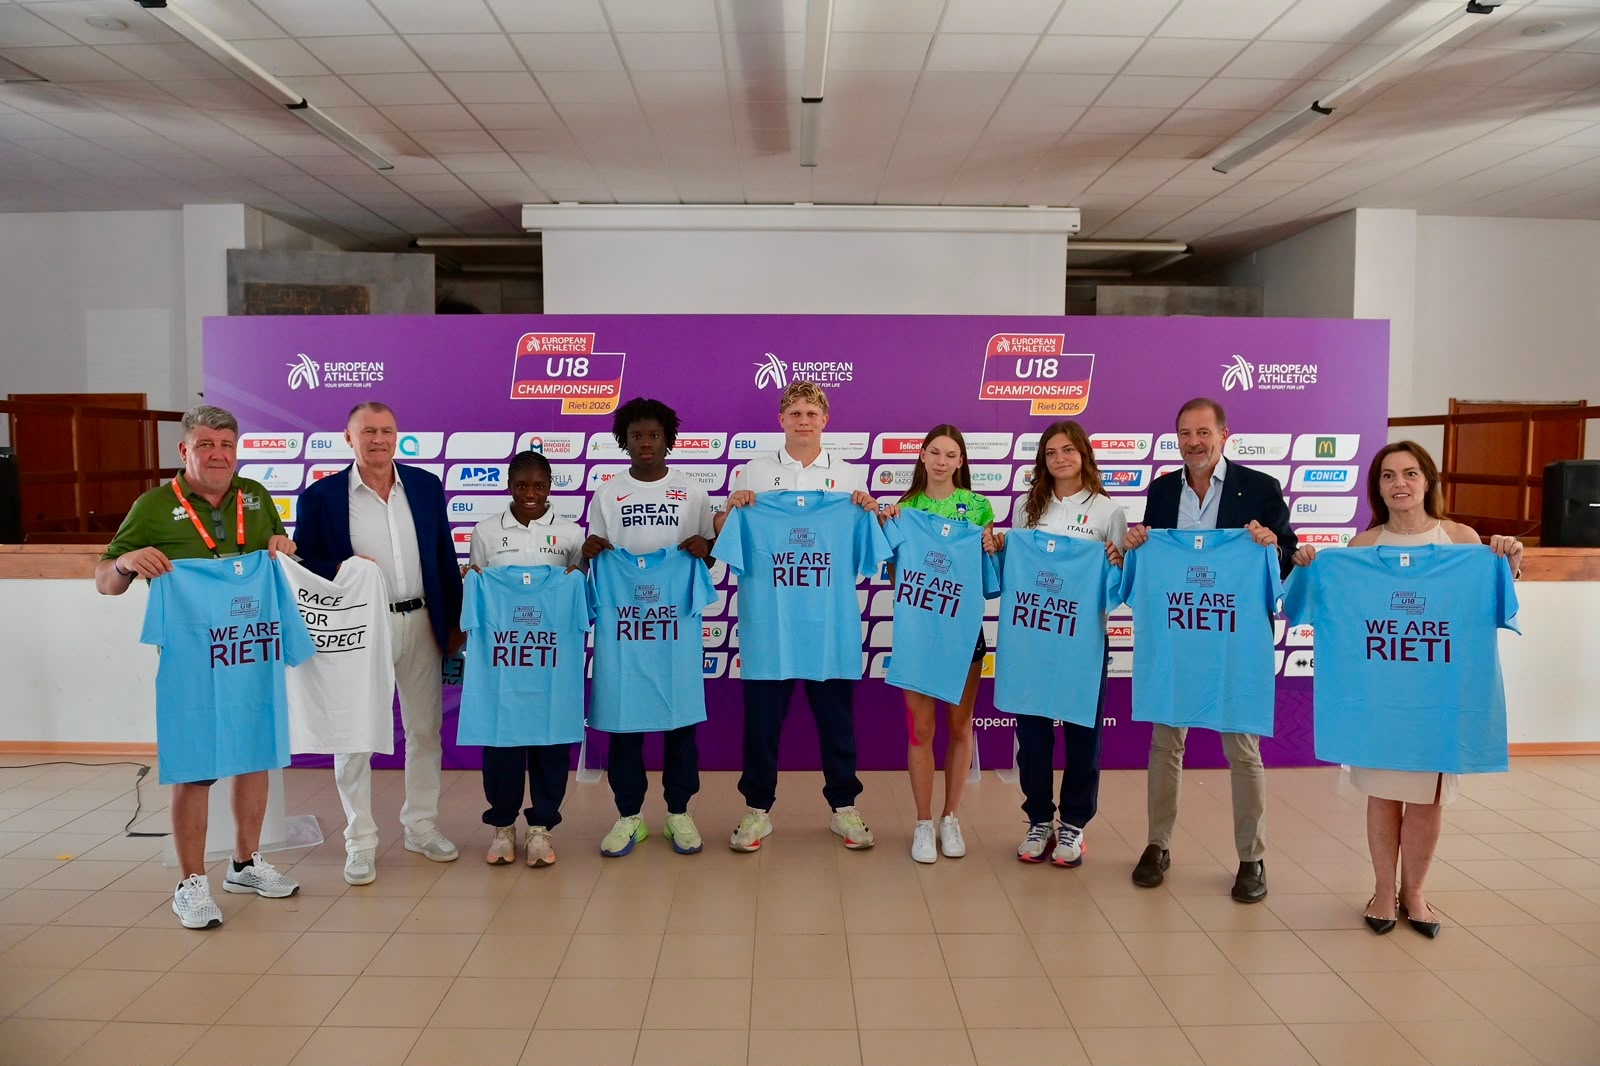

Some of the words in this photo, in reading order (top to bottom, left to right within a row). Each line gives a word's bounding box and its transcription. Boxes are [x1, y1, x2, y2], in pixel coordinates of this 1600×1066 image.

[324, 361, 384, 372] EUROPEAN
[546, 357, 589, 377] U18
[792, 361, 853, 372] EUROPEAN
[1015, 358, 1059, 378] U18
[1258, 364, 1318, 374] EUROPEAN
[324, 372, 384, 382] ATHLETICS
[792, 371, 853, 381] ATHLETICS
[1258, 374, 1317, 384] ATHLETICS
[517, 384, 614, 394] CHAMPIONSHIPS
[986, 385, 1083, 395] CHAMPIONSHIPS
[568, 401, 588, 410] Rieti
[589, 401, 611, 410] 2026
[1037, 402, 1057, 411] Rieti
[1057, 402, 1080, 411] 2026
[311, 440, 332, 449] EBU
[735, 440, 756, 449] EBU
[1238, 445, 1266, 455] asm
[460, 467, 501, 482] ADR
[1309, 471, 1345, 481] CONICA
[452, 502, 474, 512] EBU
[621, 503, 679, 516] GREAT
[1296, 503, 1317, 513] EBU
[621, 515, 679, 528] BRITAIN
[1066, 524, 1095, 536] ITALIA
[1306, 534, 1339, 543] SPAR
[539, 547, 565, 556] ITALIA
[771, 551, 795, 566] WE
[799, 552, 831, 566] ARE
[773, 566, 831, 588] RIETI
[903, 568, 927, 585] WE
[930, 576, 964, 597] ARE
[298, 588, 344, 607] RACE
[896, 583, 960, 618] RIETI
[1015, 590, 1041, 607] WE
[1044, 597, 1079, 615] ARE
[1166, 591, 1195, 606] WE
[1198, 592, 1236, 608] ARE
[616, 605, 641, 619] WE
[645, 605, 678, 620] ARE
[1012, 606, 1077, 637] RIETI
[1168, 607, 1236, 633] RIETI
[209, 626, 239, 643] WE
[243, 621, 280, 639] ARE
[616, 620, 678, 641] RIETI
[1365, 619, 1399, 635] WE
[1403, 620, 1451, 637] ARE
[493, 630, 519, 644] WE
[523, 630, 557, 645] ARE
[210, 638, 280, 669] RIETI
[1366, 637, 1451, 663] RIETI
[492, 646, 557, 668] RIETI
